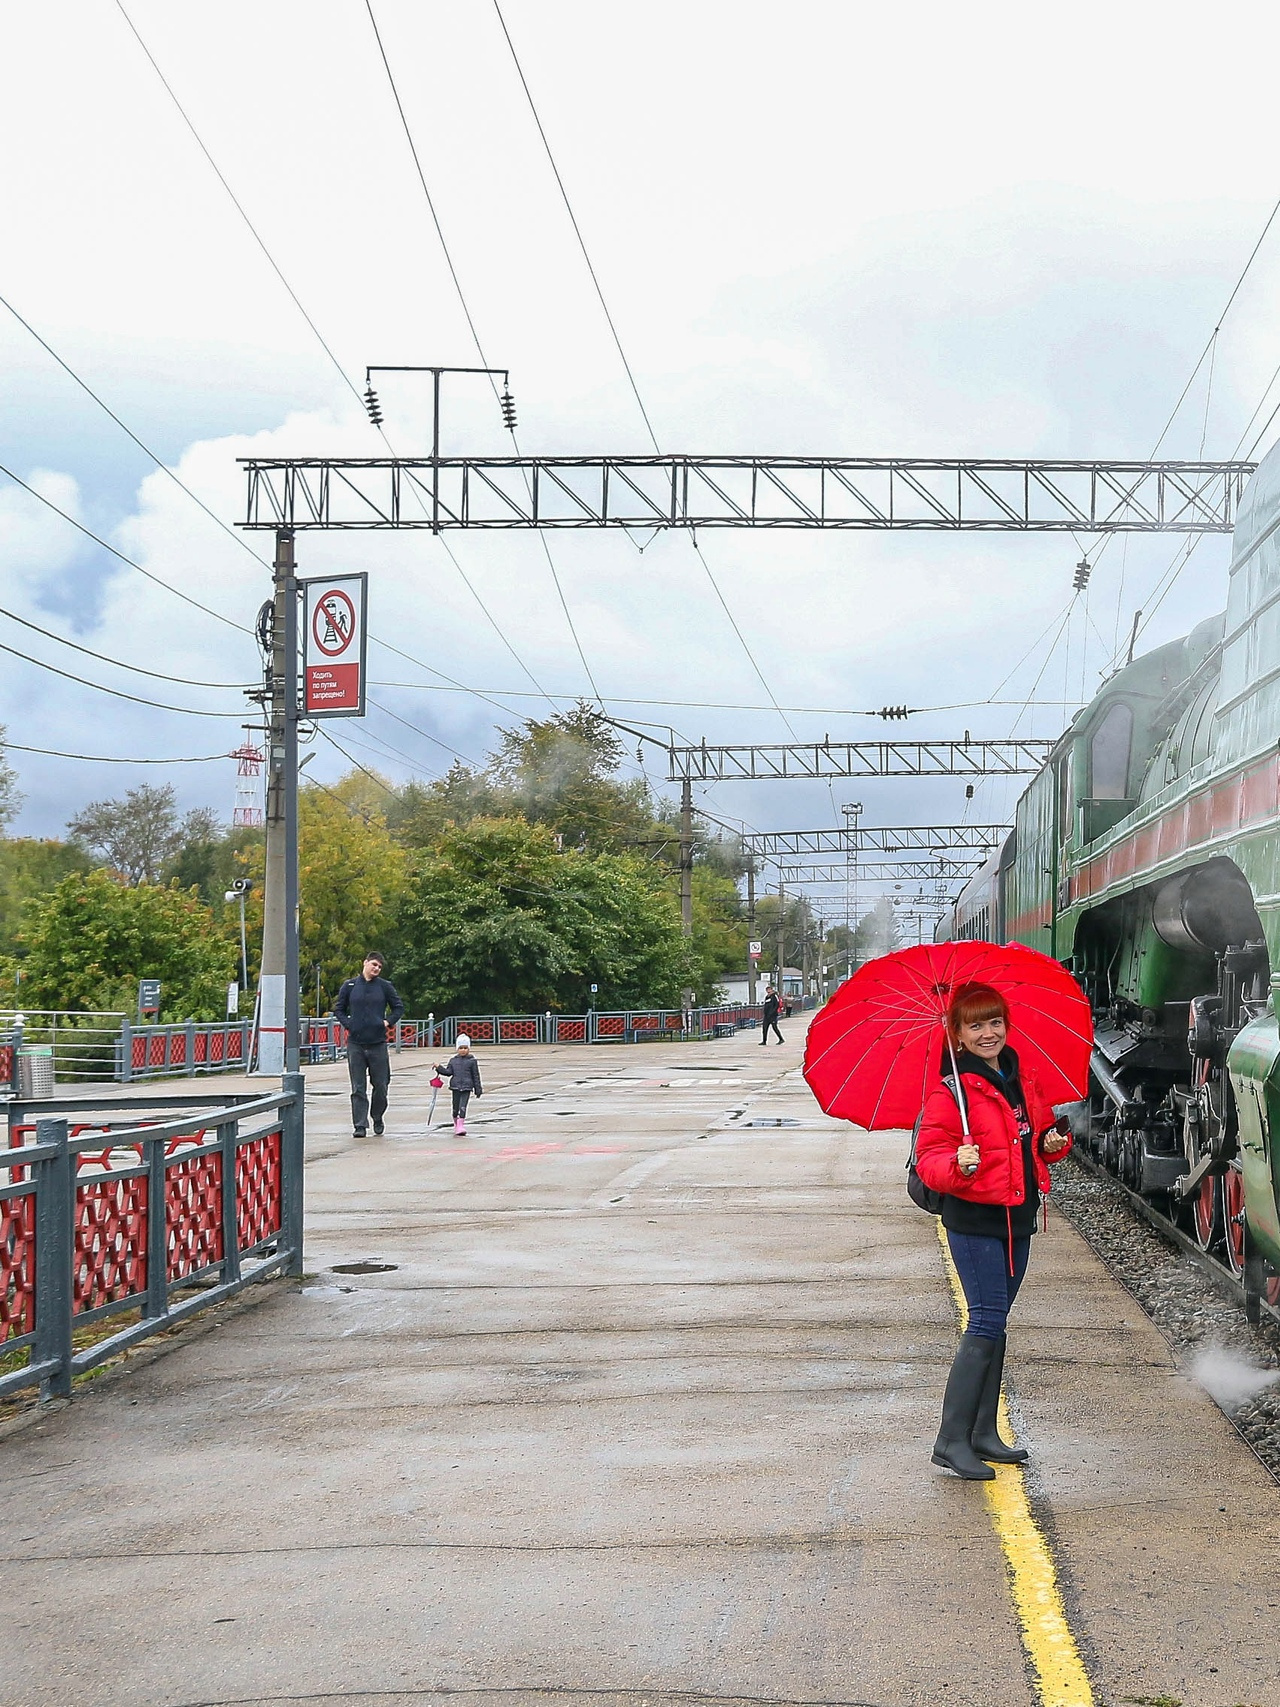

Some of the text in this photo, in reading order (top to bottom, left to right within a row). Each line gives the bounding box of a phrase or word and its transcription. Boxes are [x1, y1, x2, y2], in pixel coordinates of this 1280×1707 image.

[313, 671, 332, 679] Ходить
[321, 682, 337, 690] путям
[312, 690, 345, 699] запрещено!
